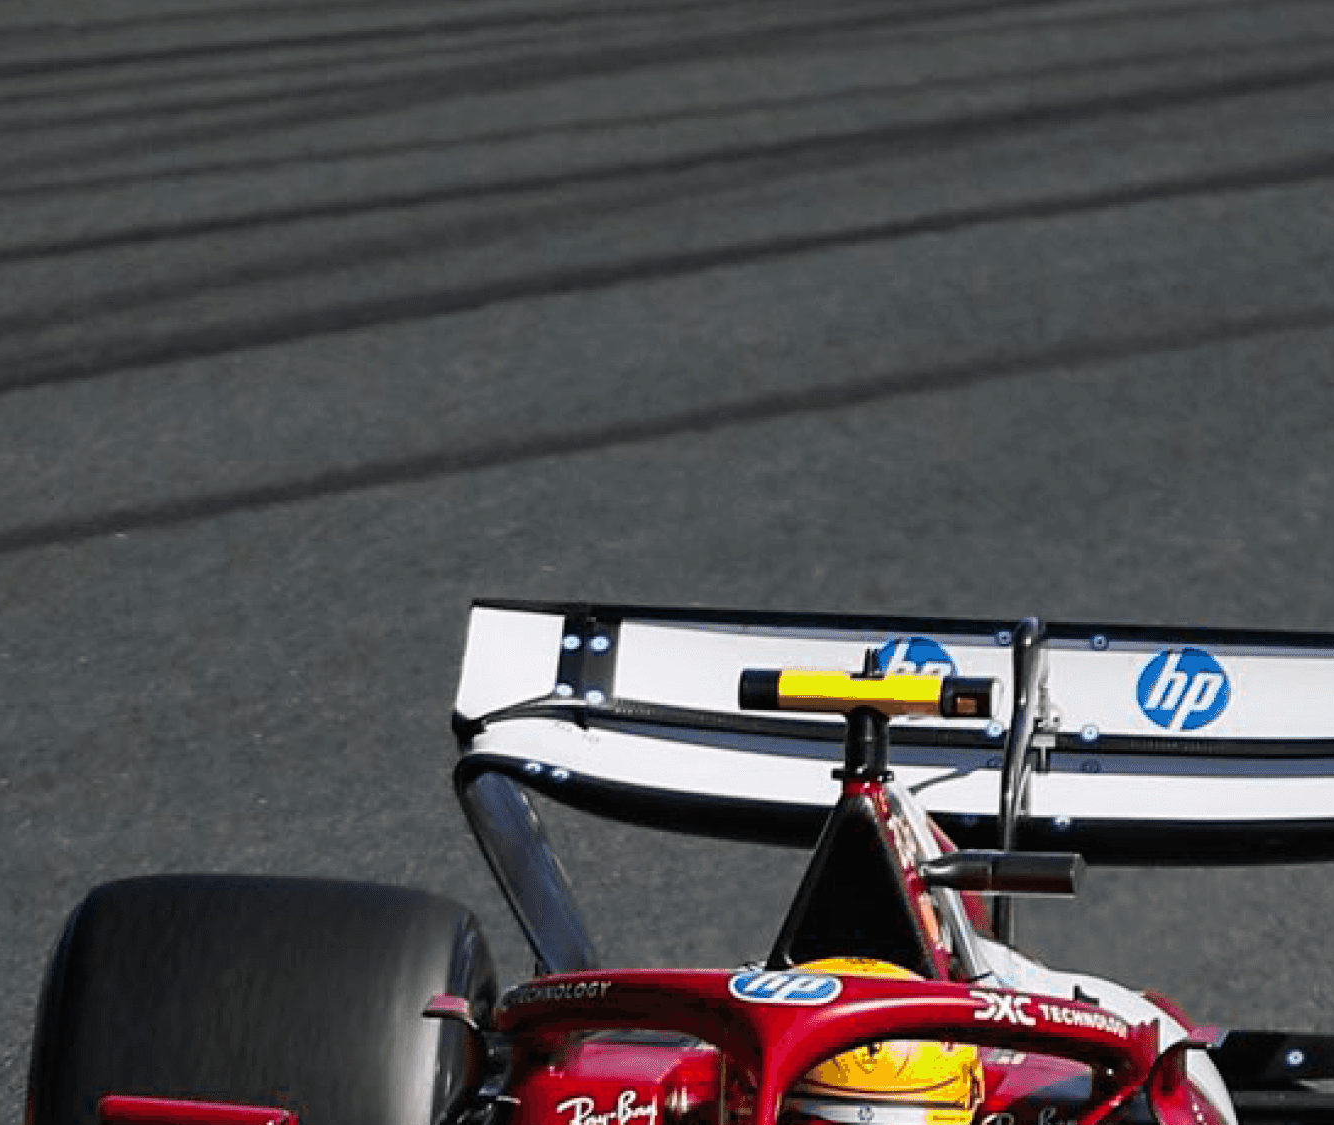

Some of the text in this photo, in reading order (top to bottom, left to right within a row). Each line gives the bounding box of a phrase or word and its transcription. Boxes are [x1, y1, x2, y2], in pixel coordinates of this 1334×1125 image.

[1141, 648, 1226, 730] hp
[741, 970, 832, 1002] hp
[969, 990, 1036, 1026] DXC
